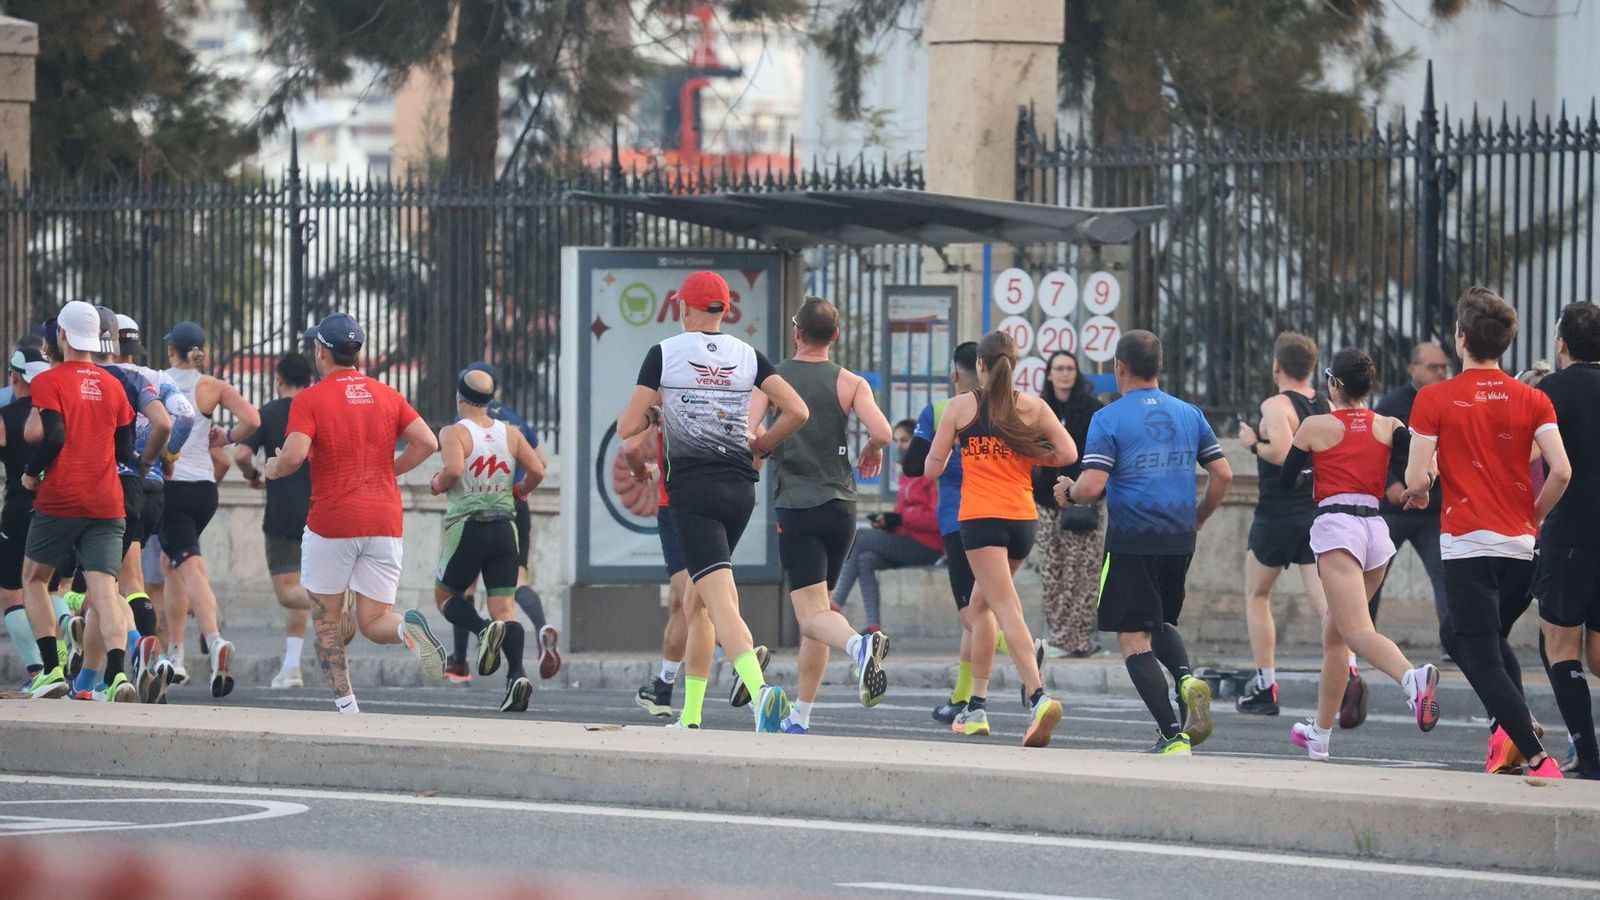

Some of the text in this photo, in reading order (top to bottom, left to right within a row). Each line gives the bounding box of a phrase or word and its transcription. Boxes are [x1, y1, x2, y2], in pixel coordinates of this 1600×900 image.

[1007, 278, 1022, 305] 5
[1050, 281, 1066, 307] 7
[1094, 280, 1110, 305] 9
[1042, 327, 1074, 353] 20
[1084, 325, 1116, 351] 27
[695, 378, 732, 387] VENUS
[1014, 367, 1046, 392] 40
[962, 445, 990, 457] CLUB
[1135, 450, 1195, 470] 23.FIT
